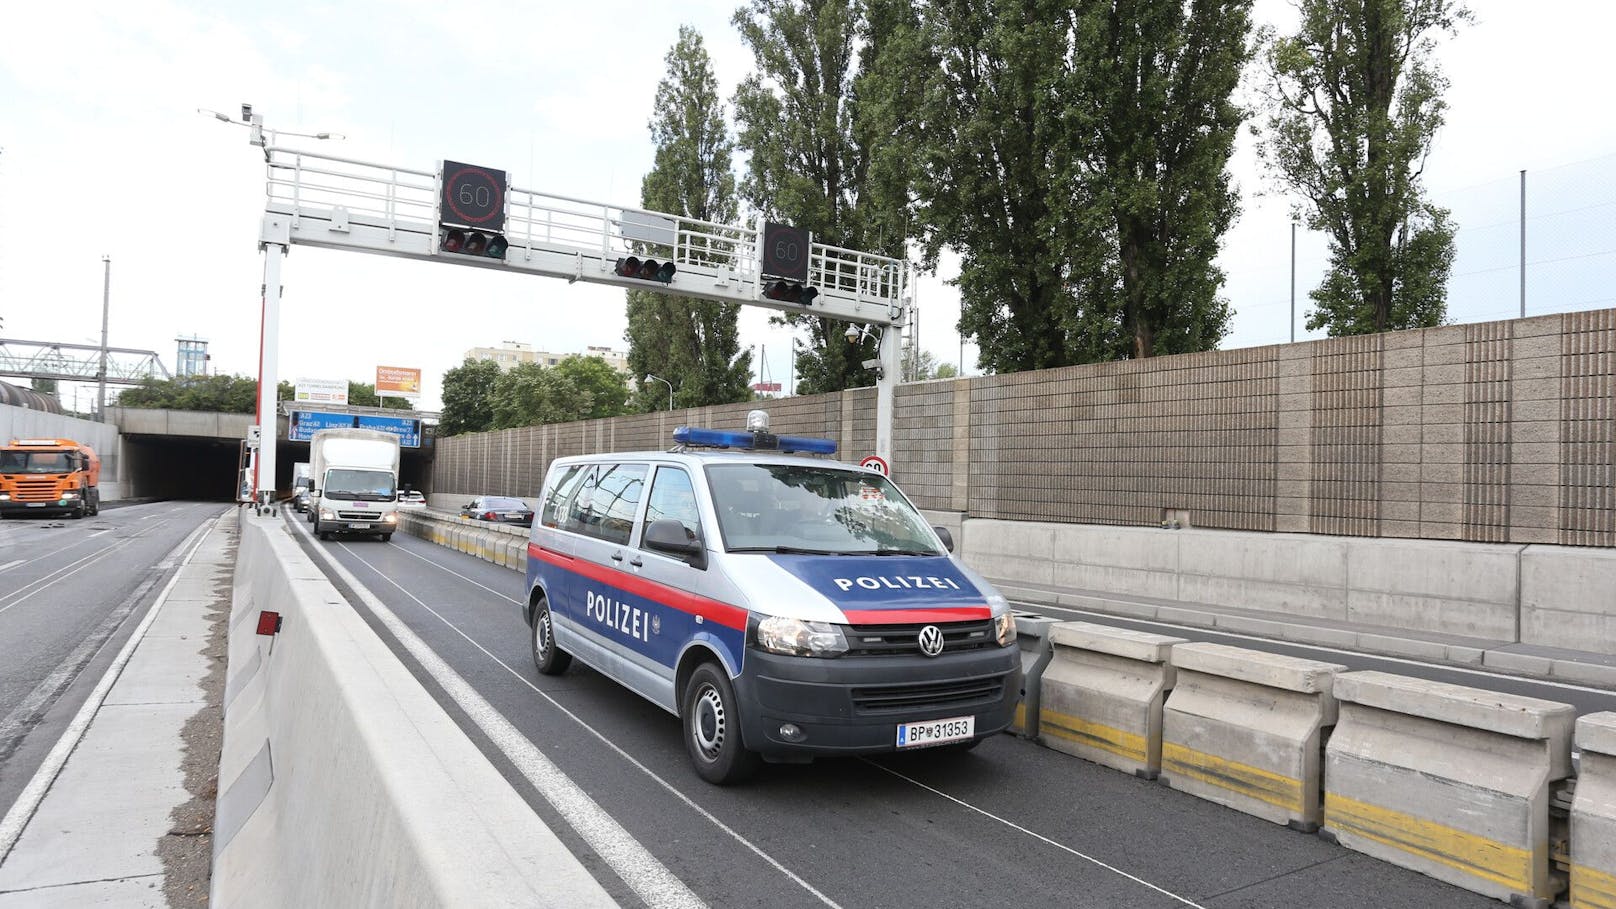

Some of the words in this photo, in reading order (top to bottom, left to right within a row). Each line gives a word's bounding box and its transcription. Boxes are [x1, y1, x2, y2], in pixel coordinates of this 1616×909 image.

[460, 184, 489, 207] 60
[776, 241, 798, 261] 60
[833, 576, 960, 591] POLIZEI
[586, 590, 649, 643] POLIZEI
[910, 726, 925, 741] BP
[934, 720, 968, 739] 31353
